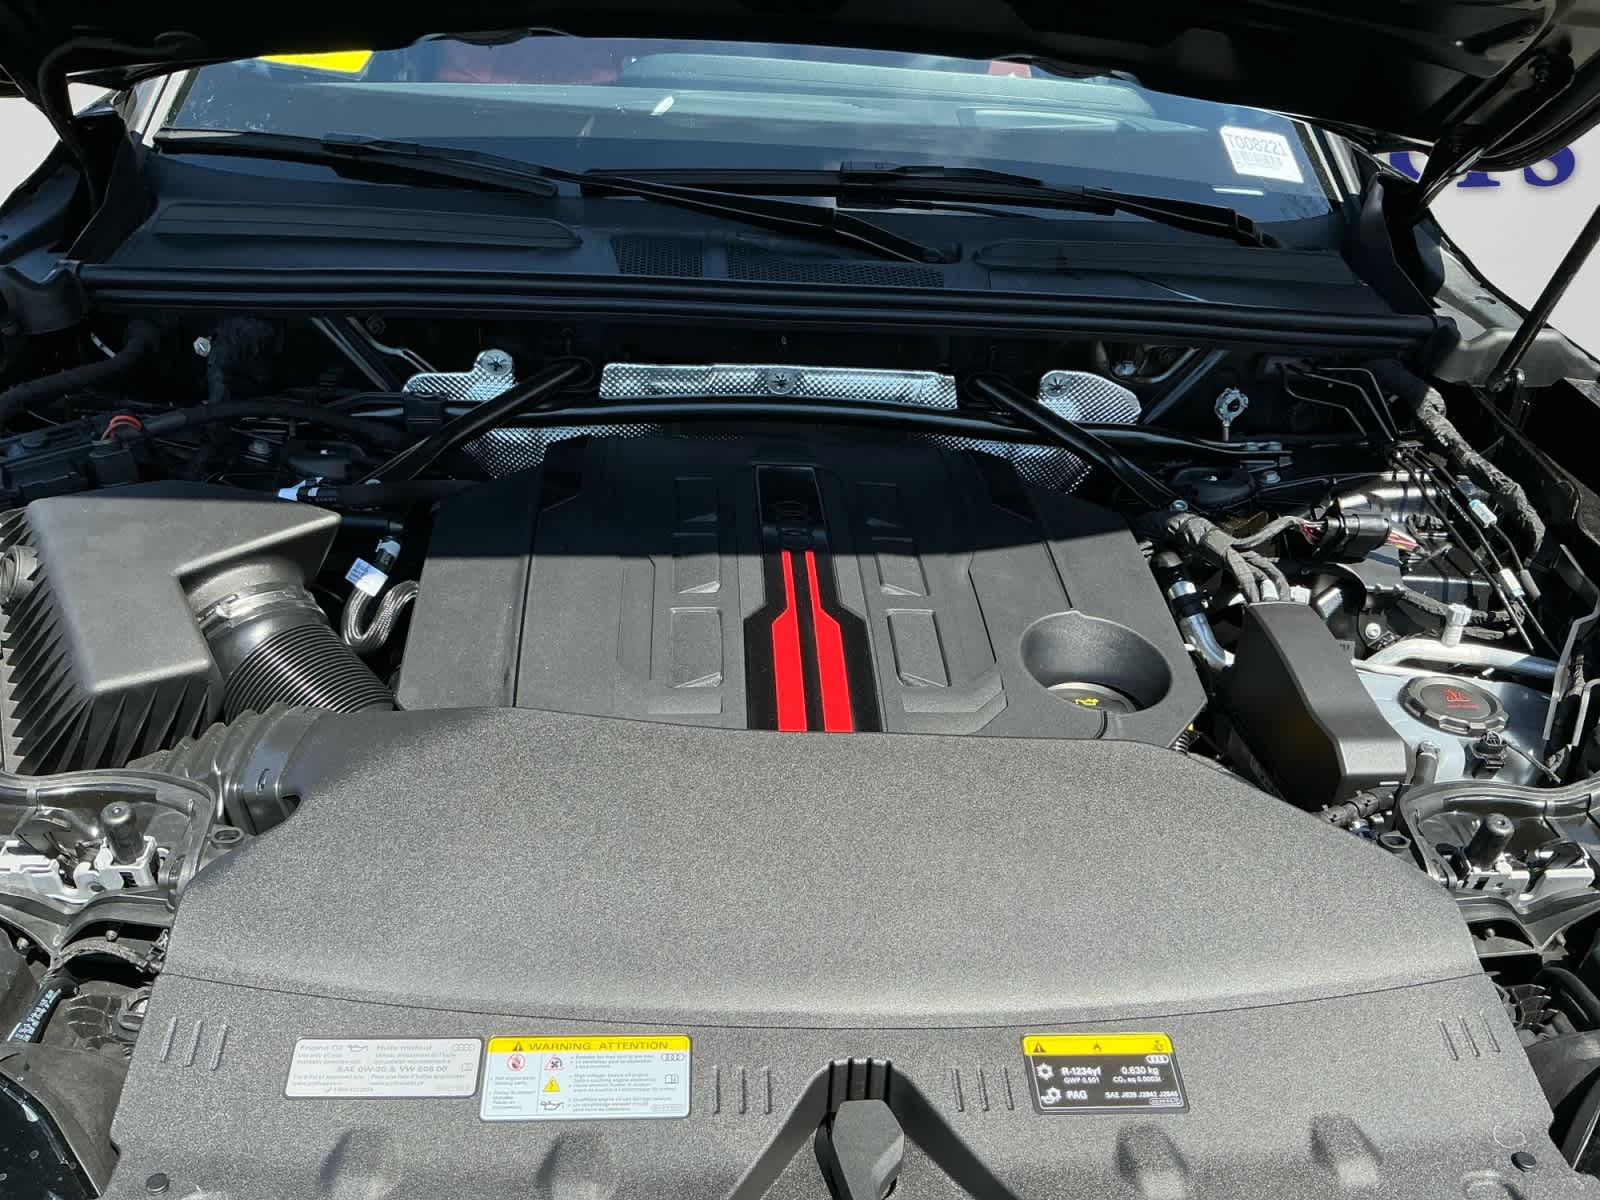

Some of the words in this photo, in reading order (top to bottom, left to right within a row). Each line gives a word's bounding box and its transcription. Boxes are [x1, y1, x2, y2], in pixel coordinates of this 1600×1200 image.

[529, 1042, 591, 1051] WARNING
[598, 1041, 669, 1051] ATTENTION
[1066, 1090, 1088, 1100] PAG
